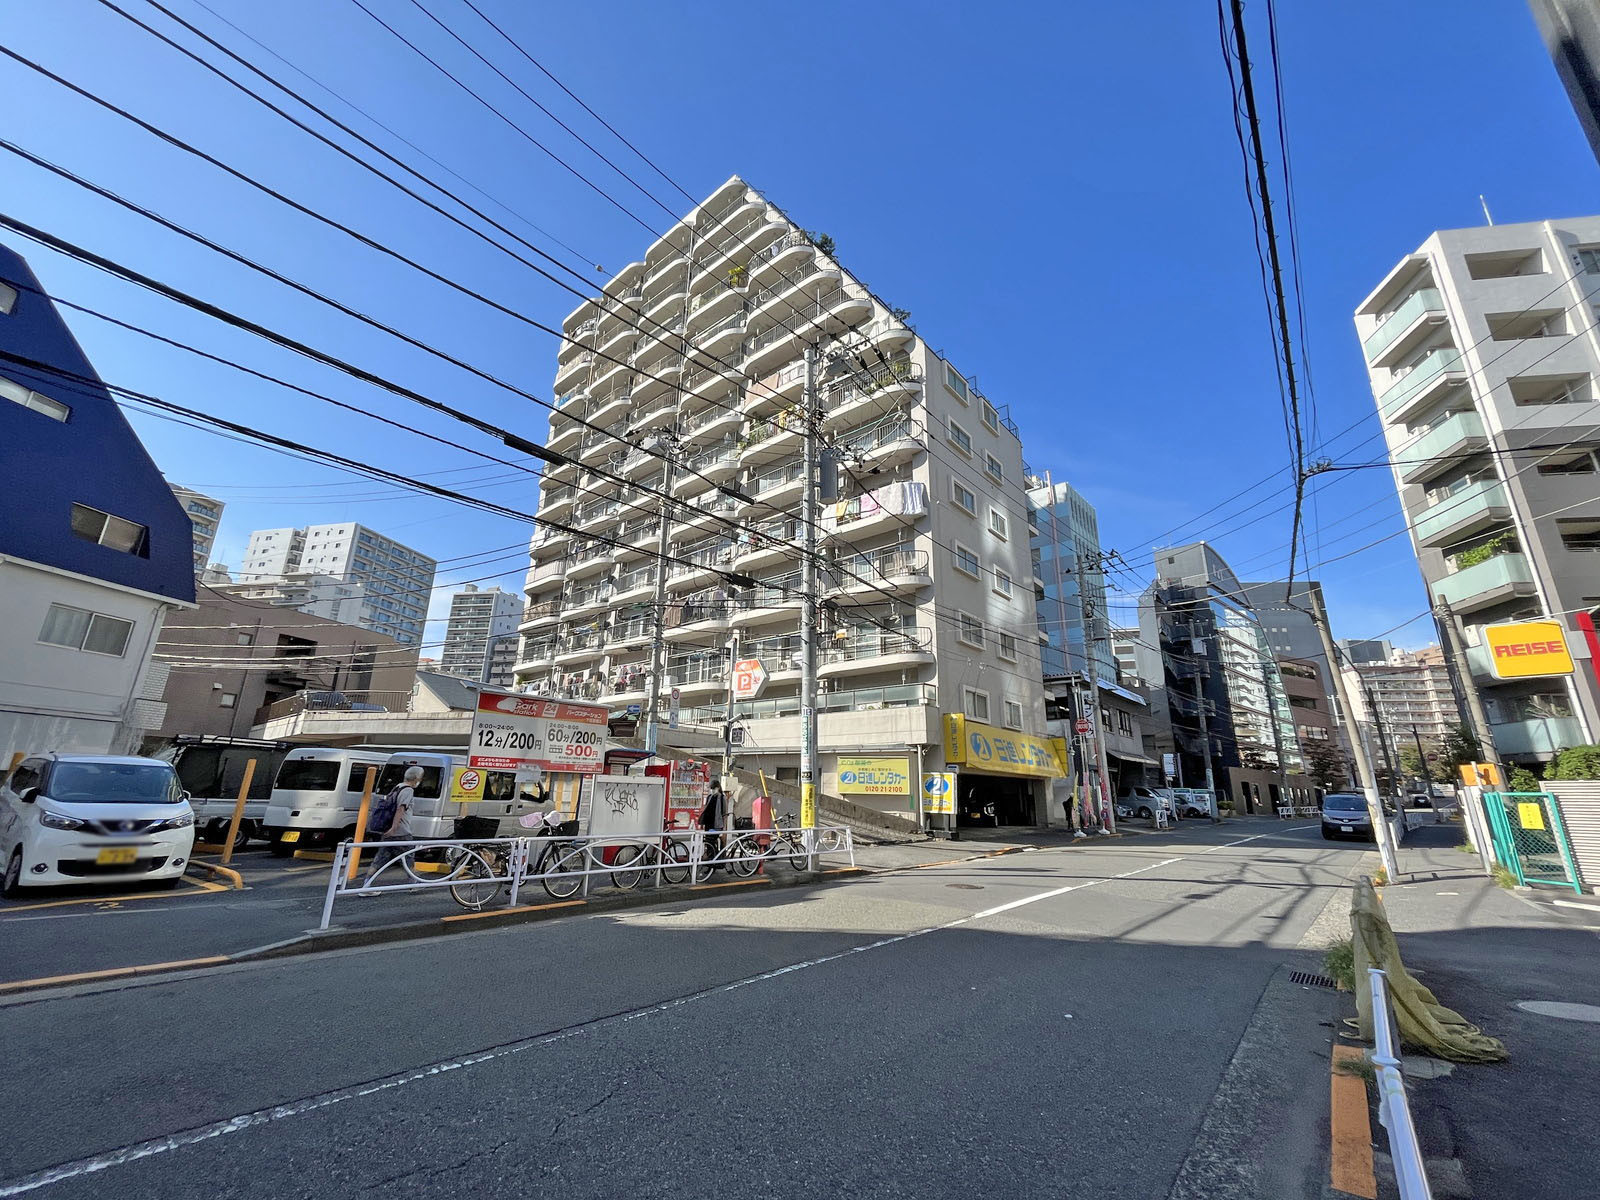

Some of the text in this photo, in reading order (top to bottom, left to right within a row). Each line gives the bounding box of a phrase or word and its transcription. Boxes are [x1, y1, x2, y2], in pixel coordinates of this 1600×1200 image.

[1494, 640, 1564, 658] REISE
[545, 703, 557, 713] 24
[564, 744, 599, 758] 500円
[992, 737, 1052, 767] 日進レンタカー
[857, 771, 907, 785] 日進レンタカー
